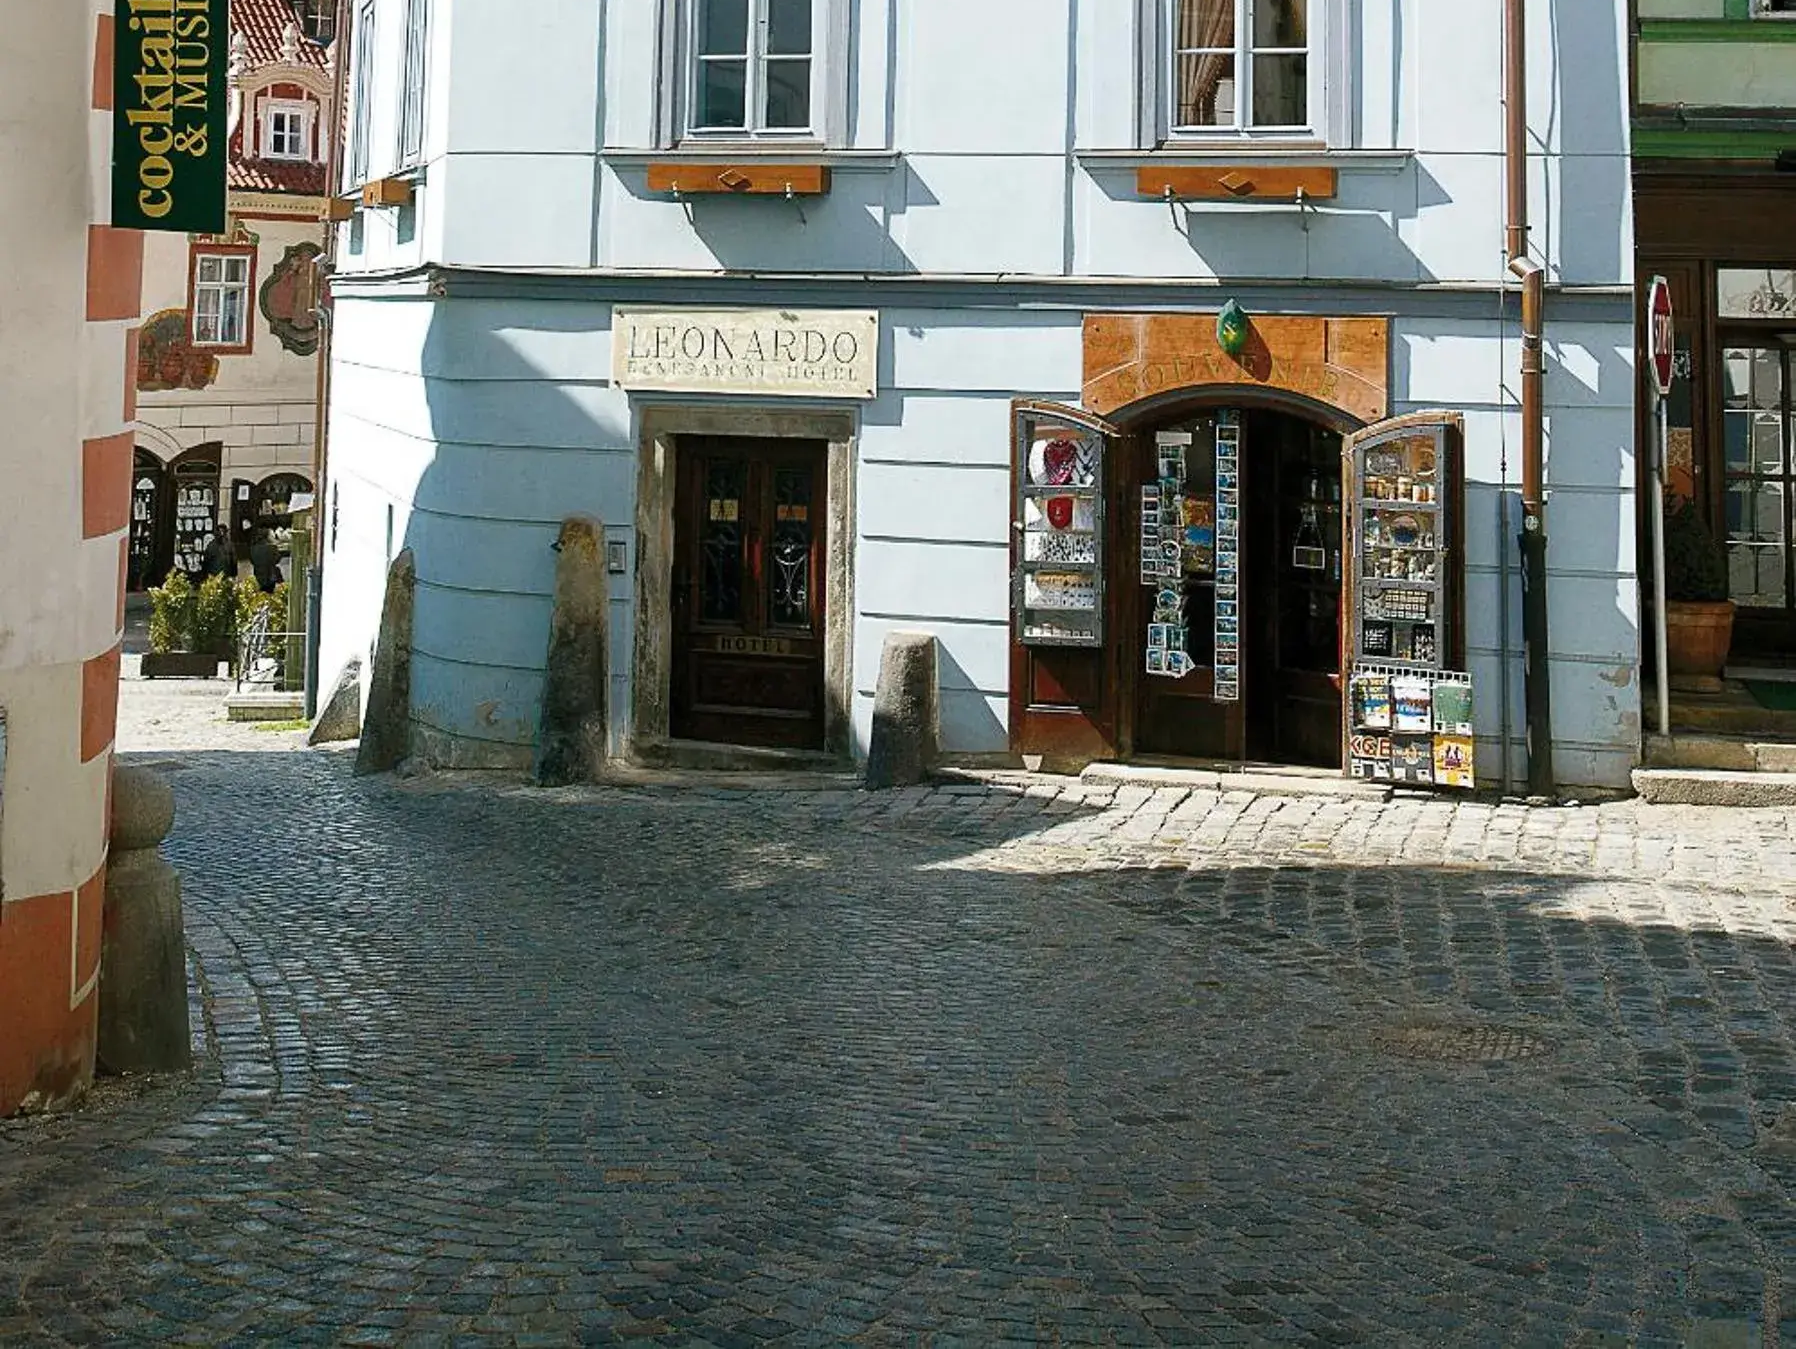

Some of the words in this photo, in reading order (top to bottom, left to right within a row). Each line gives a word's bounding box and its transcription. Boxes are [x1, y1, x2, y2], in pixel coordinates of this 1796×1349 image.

[173, 122, 208, 157] &
[628, 325, 858, 364] LEONARDO
[787, 365, 858, 382] HOTEL
[720, 637, 785, 654] HOTEL
